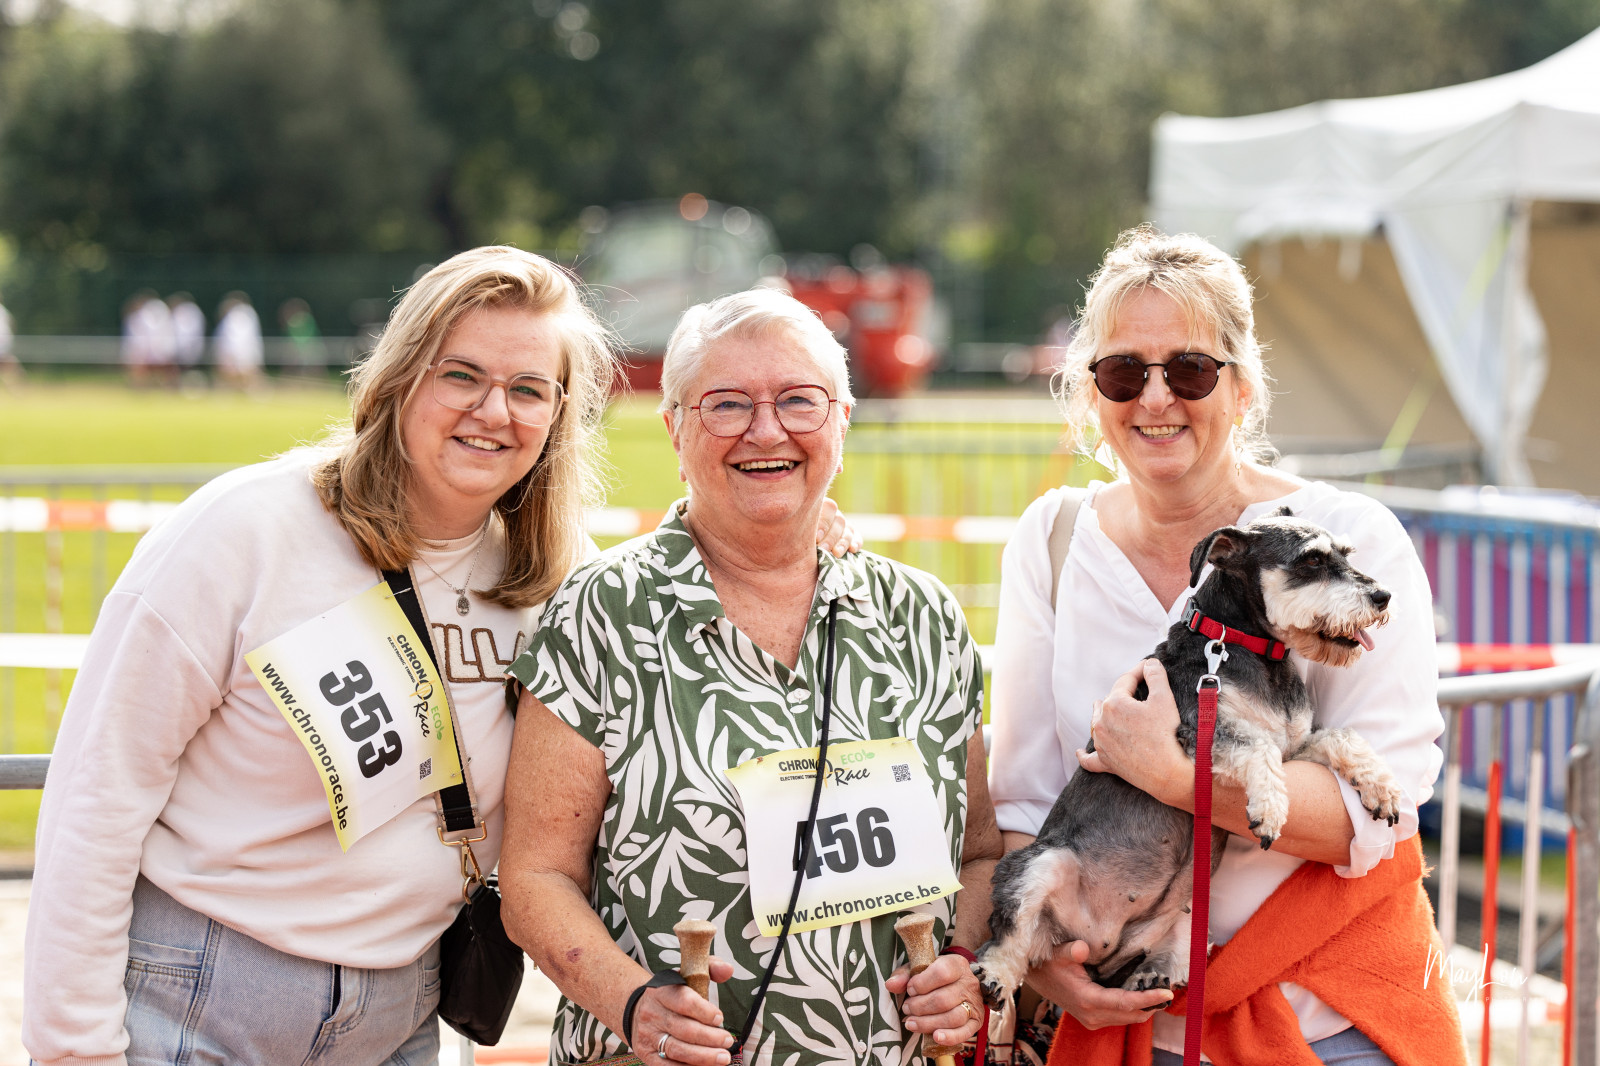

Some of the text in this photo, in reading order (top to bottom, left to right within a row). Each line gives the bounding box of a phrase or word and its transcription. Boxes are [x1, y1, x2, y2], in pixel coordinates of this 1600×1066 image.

[387, 636, 416, 683] ELECTRONIC TIMING
[318, 659, 403, 779] 353
[413, 701, 430, 737] Race
[261, 662, 349, 830] www.chronorace.be
[834, 768, 870, 786] Race
[792, 807, 896, 879] 456
[766, 883, 942, 928] www.chronorace.be
